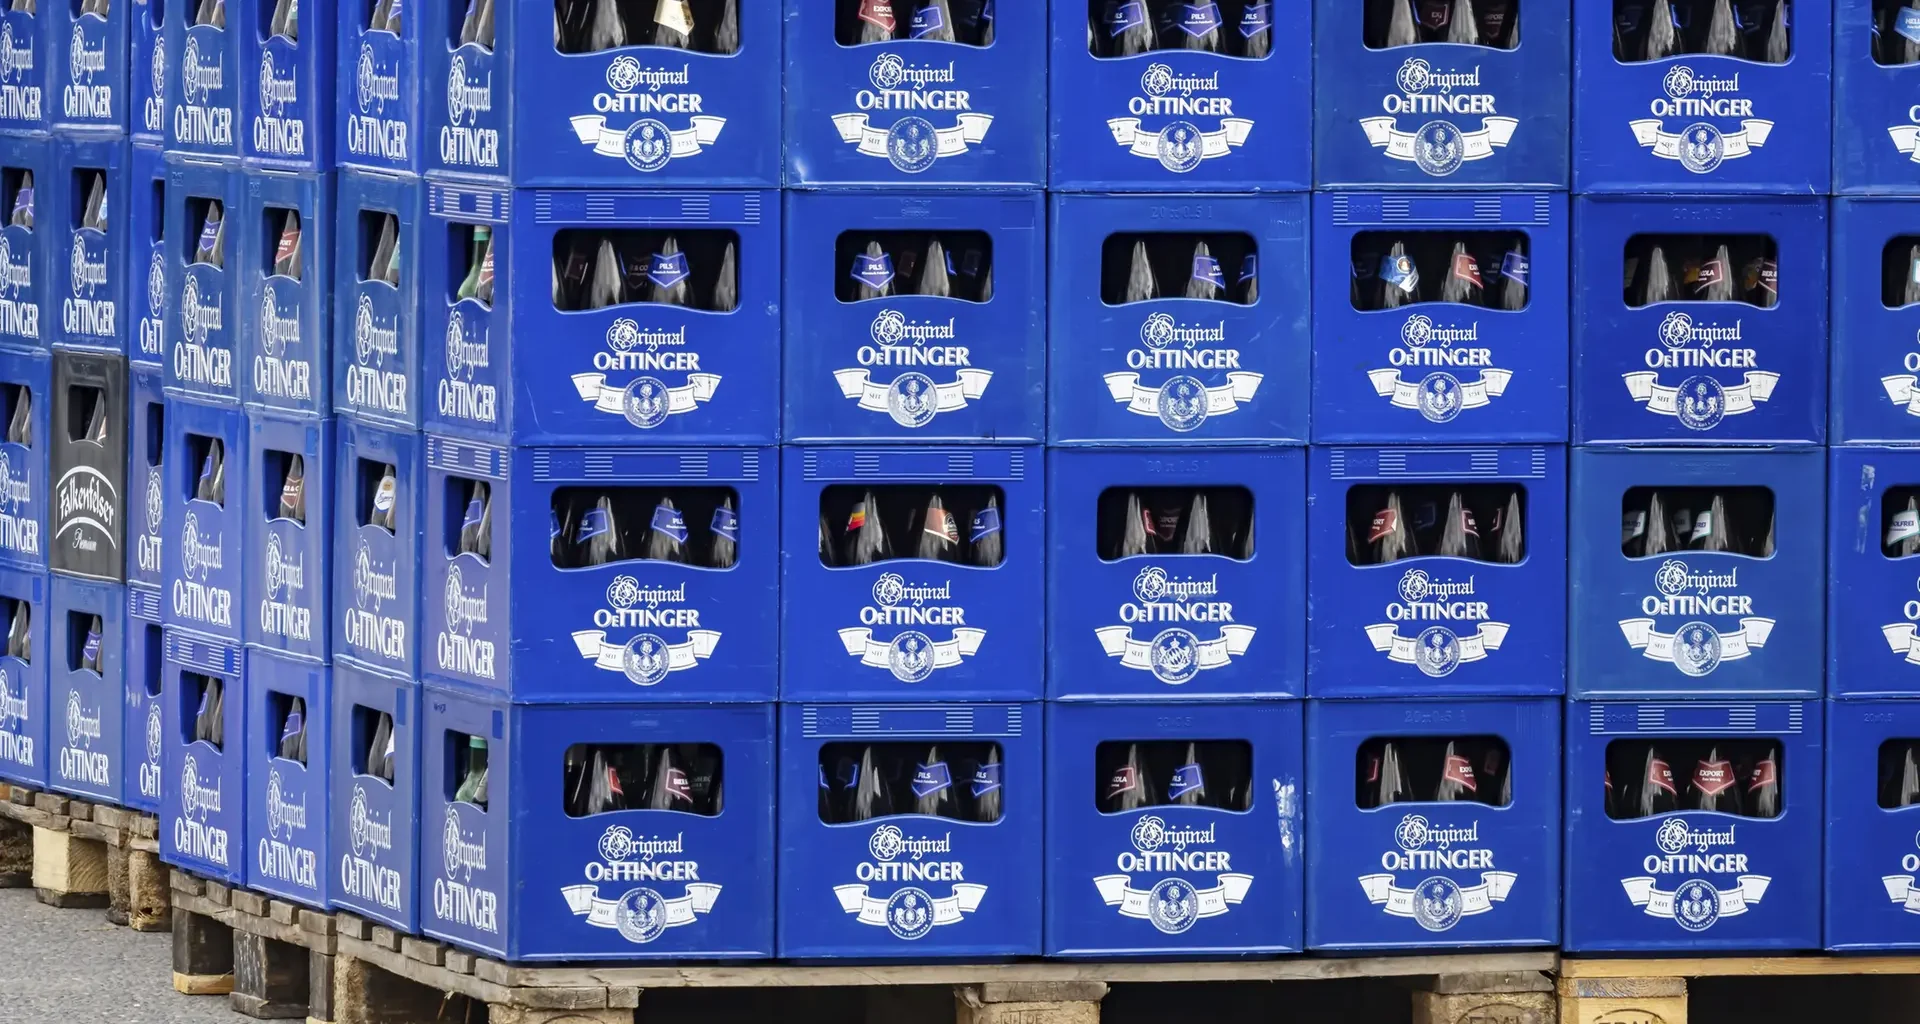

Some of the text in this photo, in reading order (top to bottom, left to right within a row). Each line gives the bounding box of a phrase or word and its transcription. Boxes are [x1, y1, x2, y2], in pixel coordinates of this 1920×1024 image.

[606, 55, 689, 92] Original
[869, 52, 955, 92] Original
[1140, 62, 1219, 98] Original
[1397, 57, 1481, 95] Original
[1663, 65, 1739, 99] Original
[606, 317, 685, 352] Original
[870, 309, 955, 347] Original
[1140, 312, 1224, 351] Original
[1401, 314, 1478, 350] Original
[1658, 311, 1742, 348] Original
[60, 476, 114, 526] Falkenfelser
[606, 574, 685, 610] Original
[872, 572, 951, 608] Original
[1132, 565, 1218, 604] Original
[1398, 569, 1475, 602] Original
[1655, 559, 1737, 596] Original
[599, 825, 683, 862] Original
[869, 824, 951, 861] Original
[1131, 814, 1215, 853] Original
[1394, 814, 1479, 852] Original
[1656, 818, 1735, 853] Original
